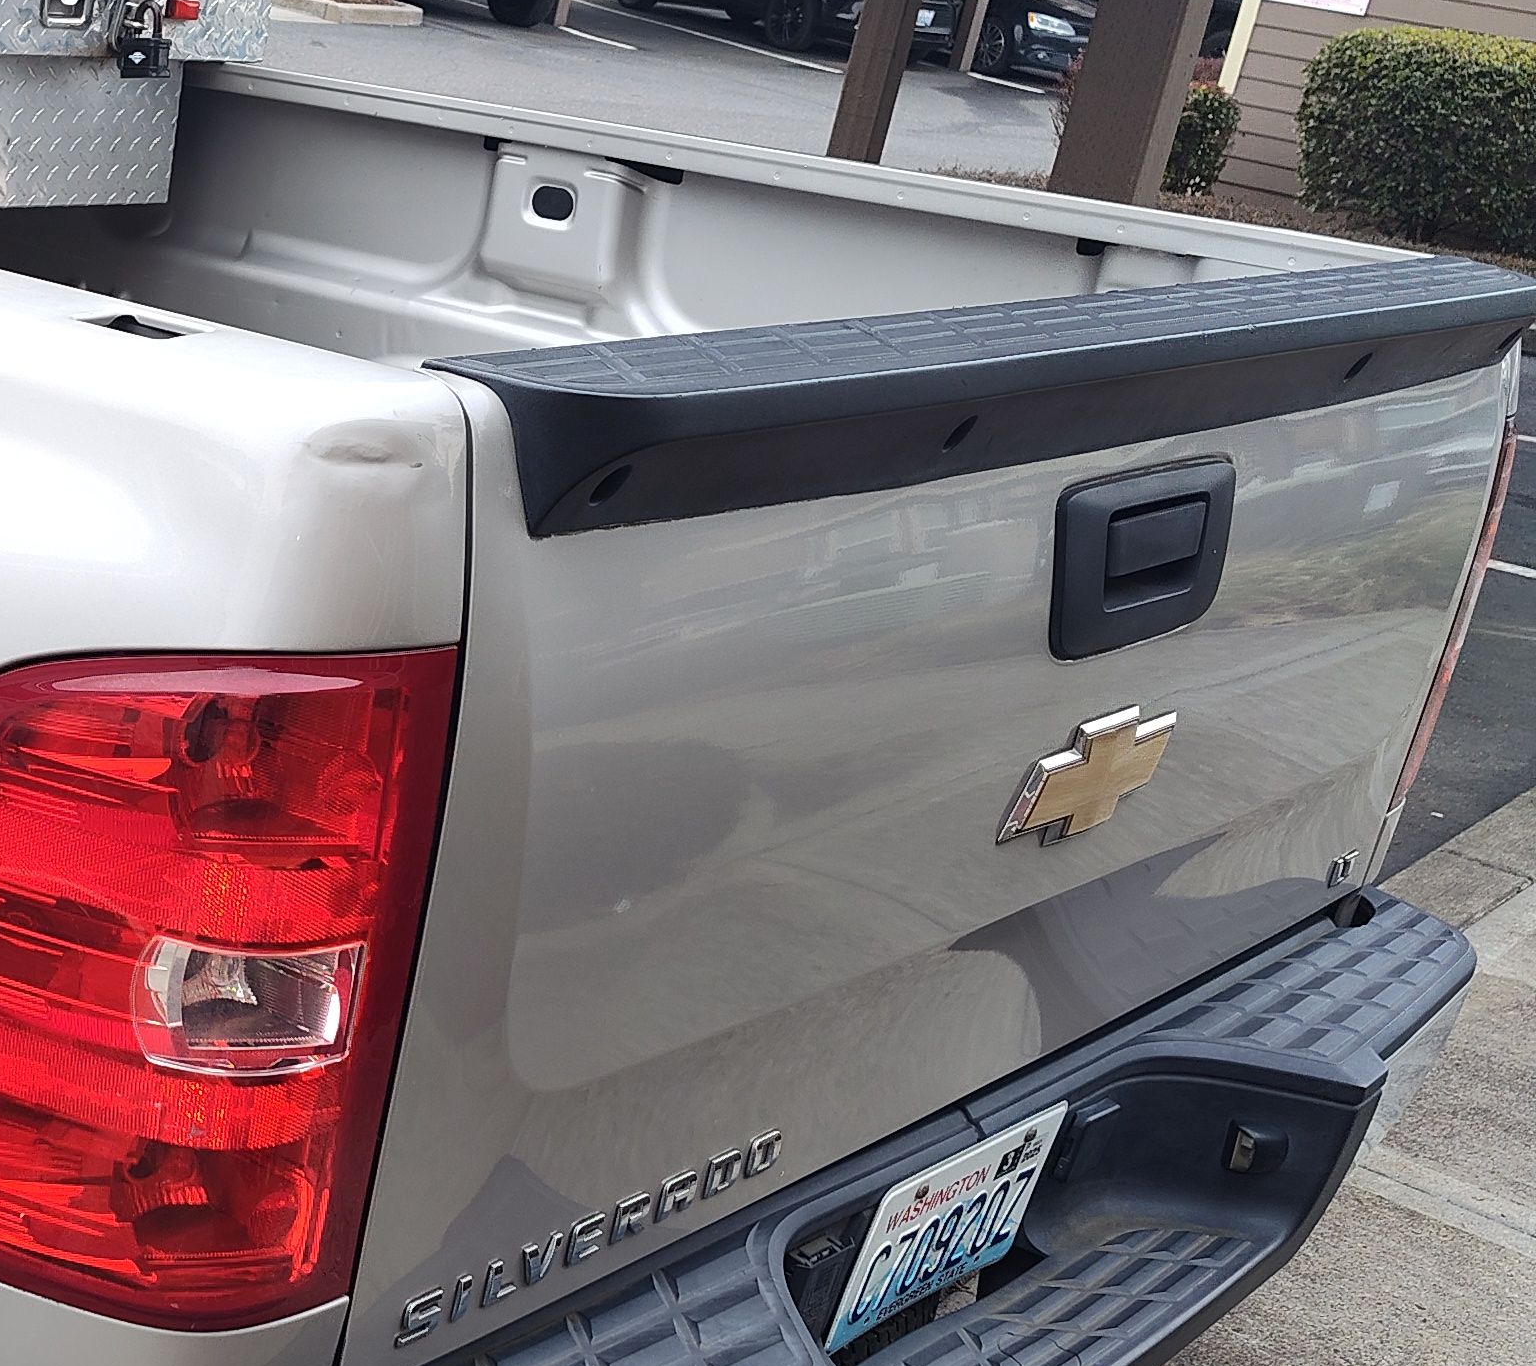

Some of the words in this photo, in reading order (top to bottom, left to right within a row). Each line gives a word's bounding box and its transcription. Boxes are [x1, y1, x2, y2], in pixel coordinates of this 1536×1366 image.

[885, 1164, 992, 1234] WASHINGTON
[394, 1128, 782, 1349] SILVERADO
[876, 1280, 935, 1322] EVERGREEN
[935, 1264, 967, 1287] STATE
